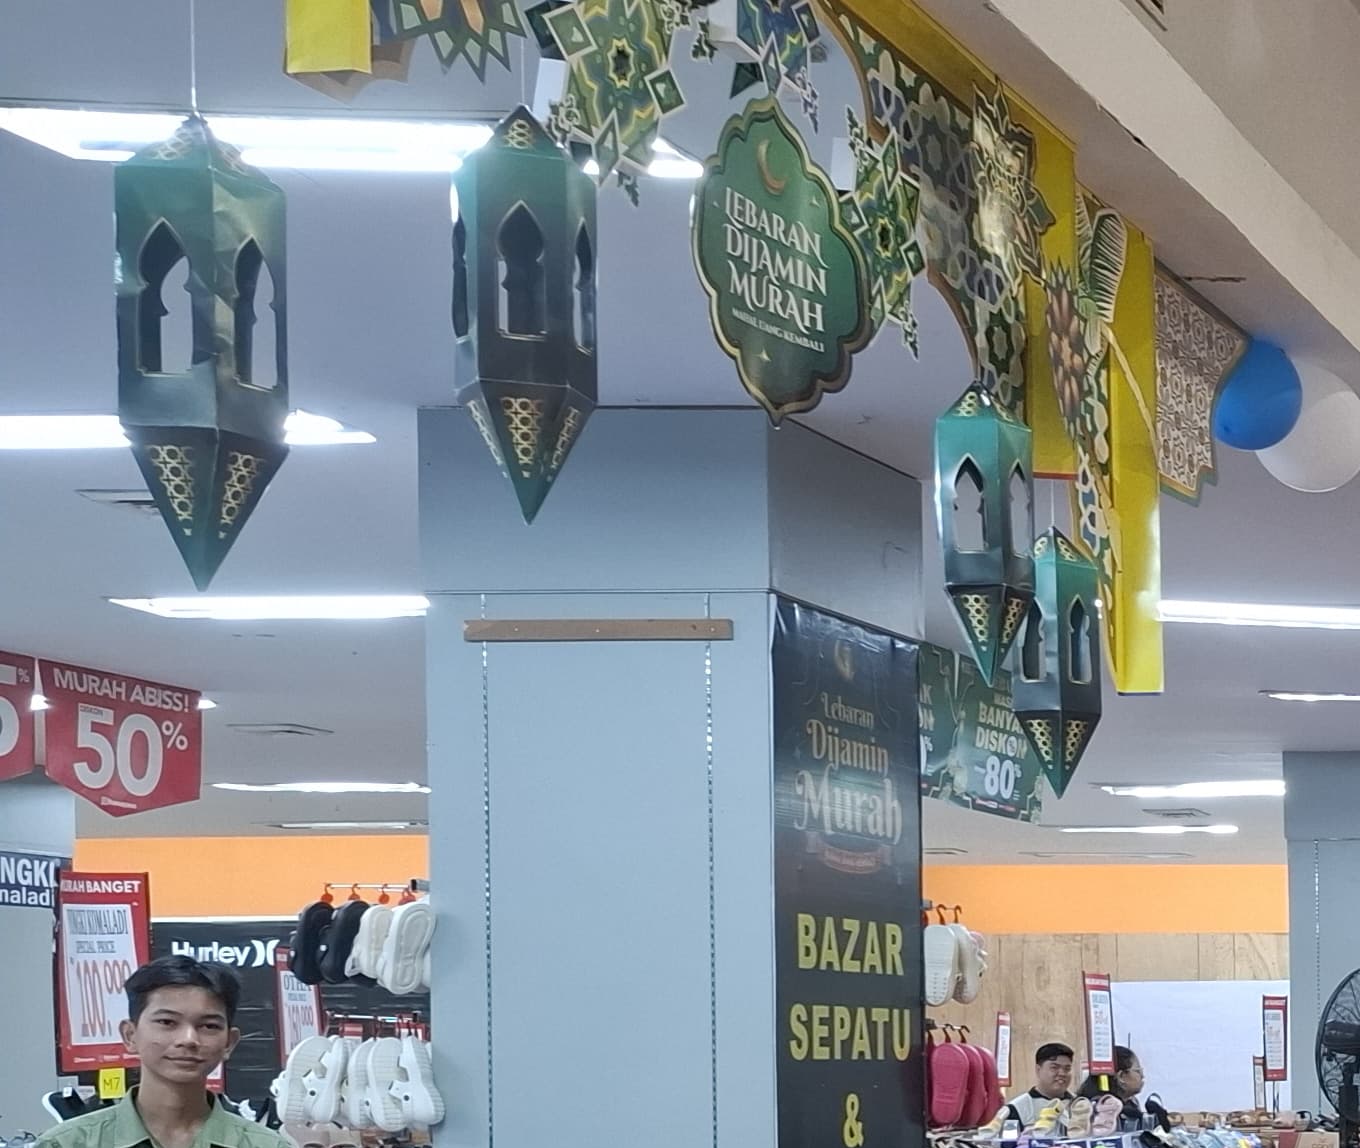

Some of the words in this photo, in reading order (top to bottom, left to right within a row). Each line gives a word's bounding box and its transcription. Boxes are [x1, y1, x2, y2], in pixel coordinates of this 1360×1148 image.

[725, 187, 830, 268] LEBARAN
[723, 223, 827, 296] DIJAMIN
[727, 260, 825, 335] MURAH
[53, 668, 126, 701] MURAH
[130, 685, 190, 713] ABISS!
[820, 690, 875, 732] Lebaran
[978, 700, 1024, 734] BANYA
[806, 718, 890, 778] Dijamin
[793, 762, 903, 846] Murah
[86, 879, 141, 894] BANGET
[171, 940, 251, 967] Hurley
[796, 913, 905, 977] BAZAR
[789, 1003, 912, 1062] SEPATU
[103, 1076, 121, 1091] M7
[842, 1092, 865, 1148] &
